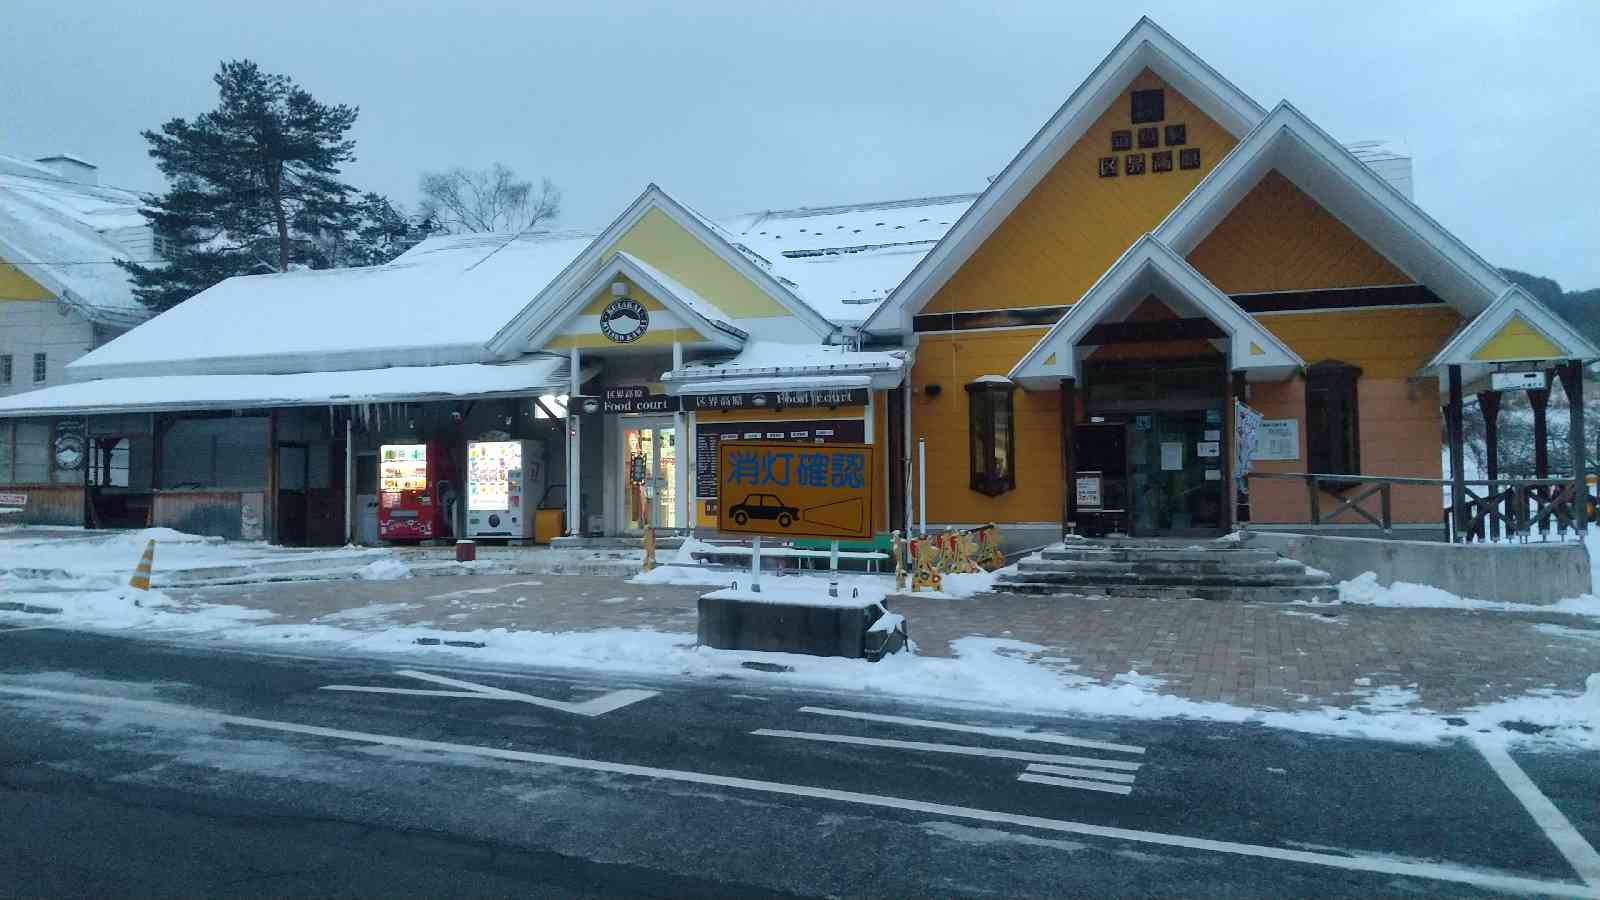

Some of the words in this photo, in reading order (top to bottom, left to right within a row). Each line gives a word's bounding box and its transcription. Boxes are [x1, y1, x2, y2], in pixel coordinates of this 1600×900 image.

[604, 400, 632, 411] Food
[637, 400, 668, 410] court
[727, 450, 866, 489] 消灯確認
